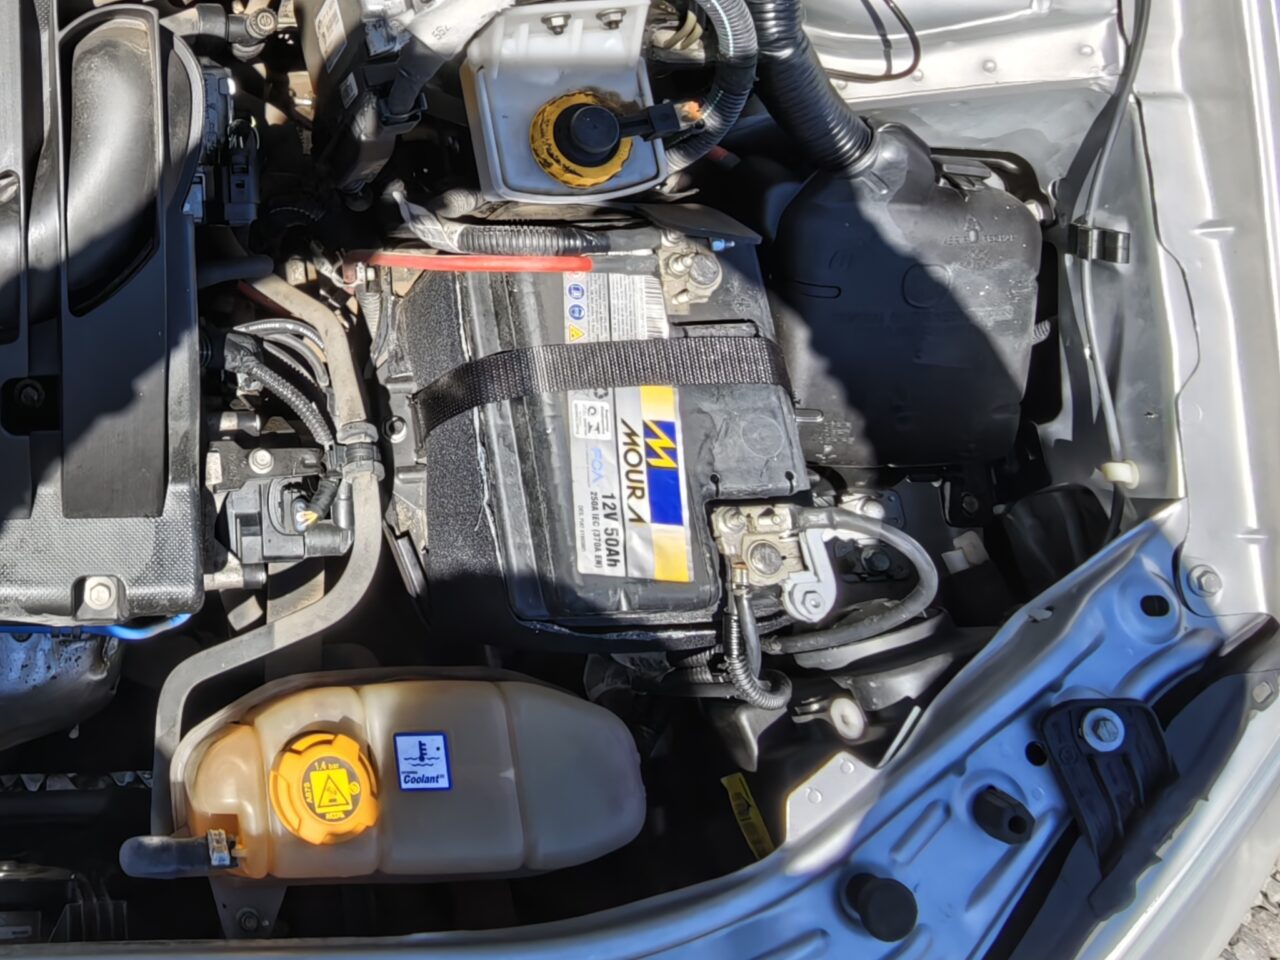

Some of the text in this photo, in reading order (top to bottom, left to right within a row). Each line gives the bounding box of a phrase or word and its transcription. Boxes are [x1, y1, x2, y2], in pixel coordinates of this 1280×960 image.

[620, 418, 649, 525] MOURA
[590, 491, 598, 512] 250A
[592, 513, 601, 527] IEC
[601, 493, 621, 568] 12V 50Ah
[403, 773, 439, 784] Coolant
